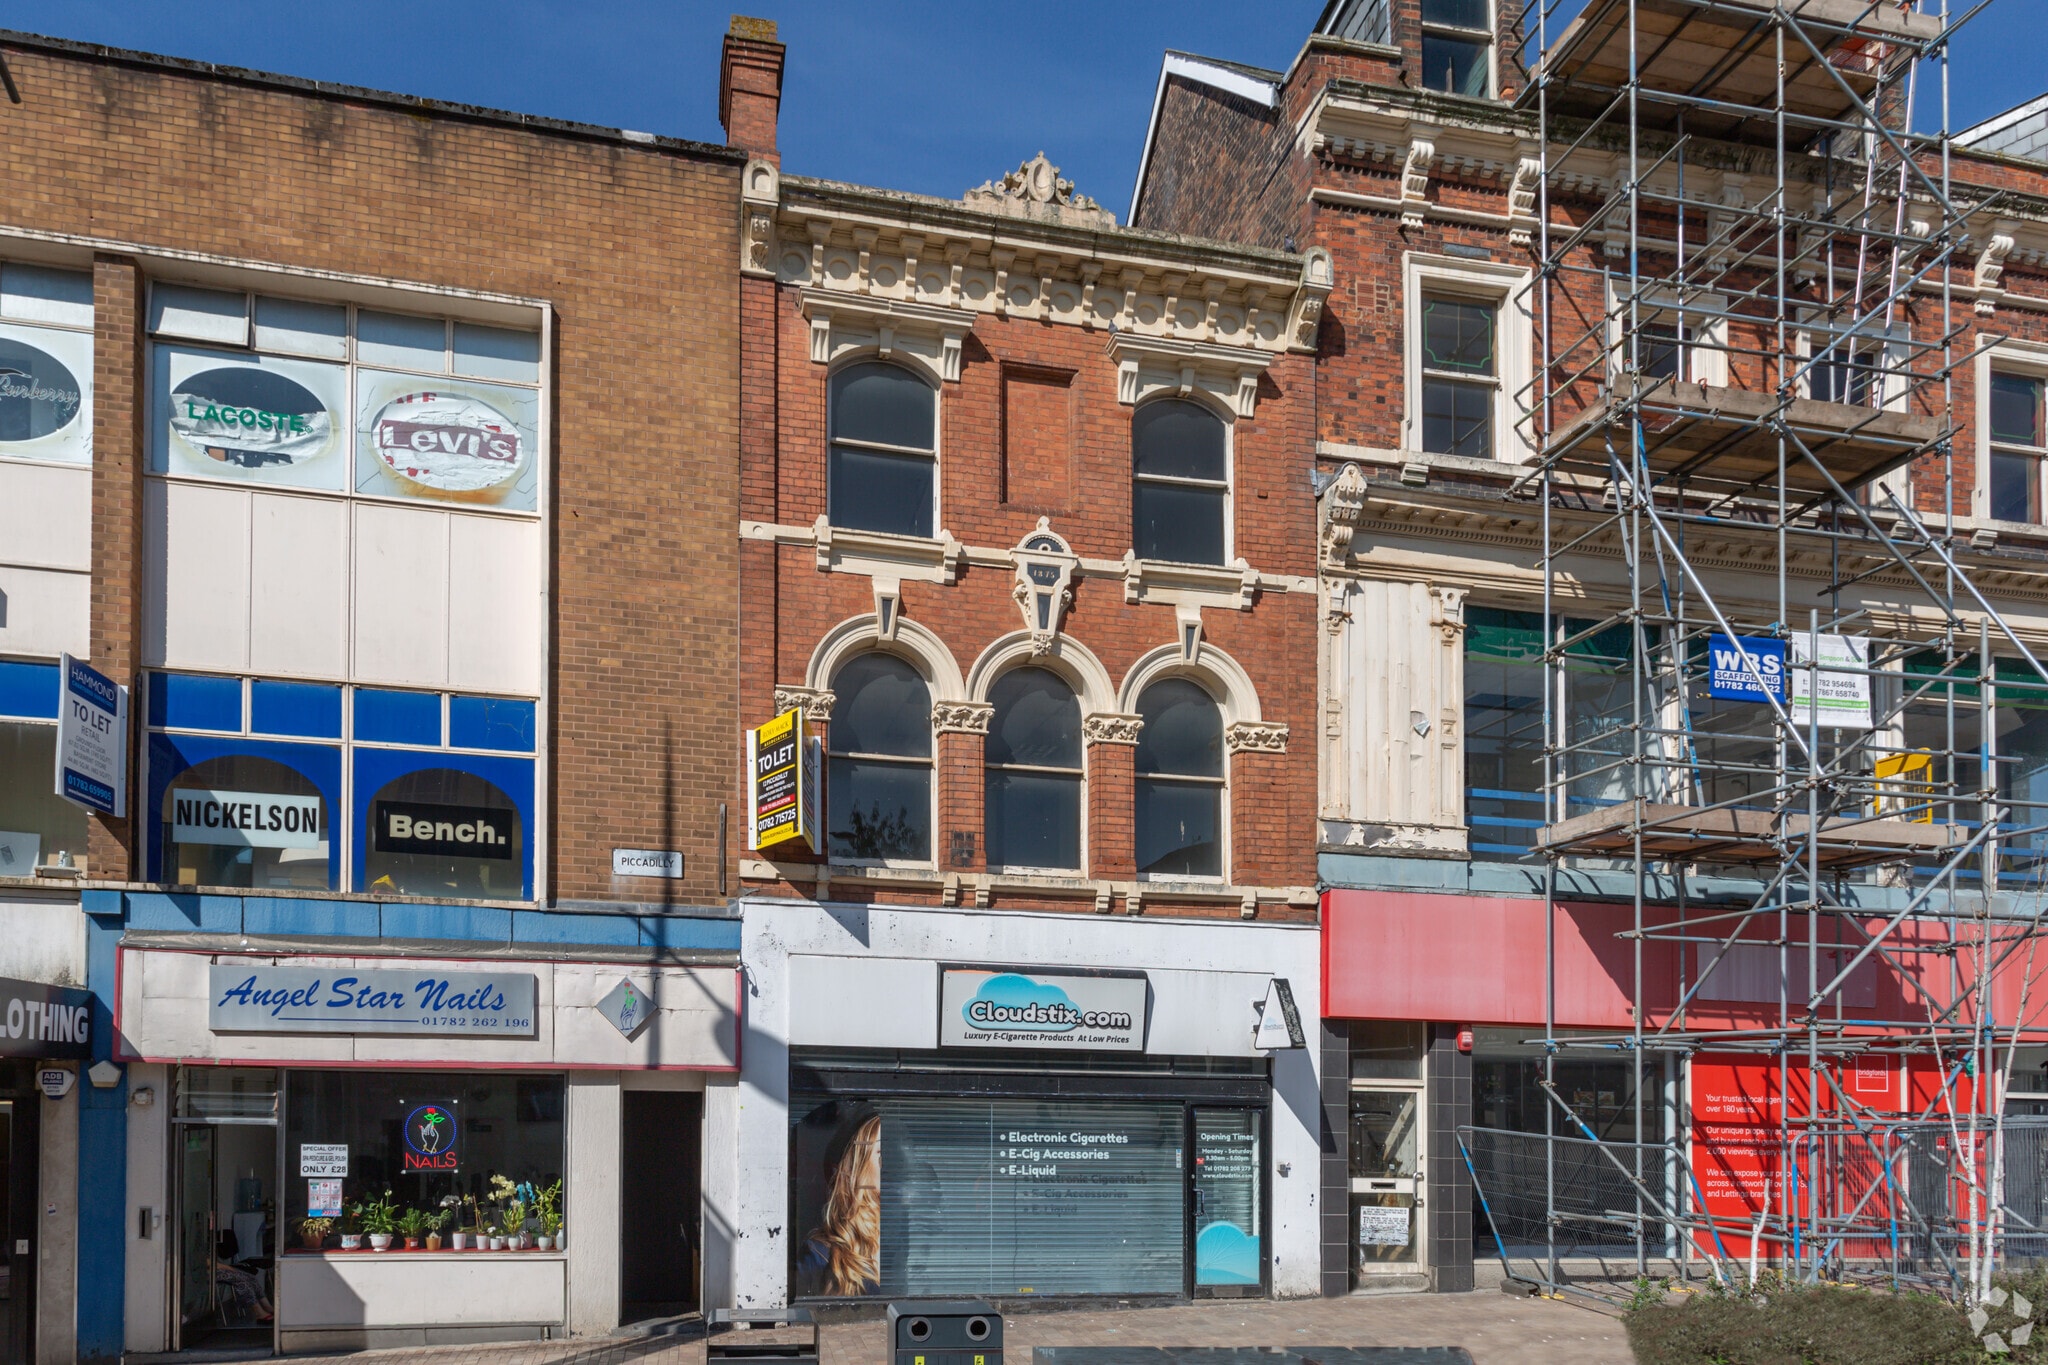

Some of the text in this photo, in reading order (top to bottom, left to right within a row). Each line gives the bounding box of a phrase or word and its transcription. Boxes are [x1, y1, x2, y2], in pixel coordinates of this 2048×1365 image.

[188, 402, 305, 433] LACOSTE
[382, 425, 513, 459] Levi's
[1714, 649, 1780, 674] WBS
[71, 666, 115, 701] HAMMOND
[1714, 681, 1743, 690] 01782
[72, 700, 111, 735] TO LET
[81, 725, 100, 743] RETAIL
[758, 754, 772, 773] TO
[773, 743, 794, 767] LET
[68, 775, 88, 792] 01782
[176, 799, 317, 833] NICKELSON
[758, 808, 796, 831] 01782 715725
[389, 814, 506, 845] Bench.
[621, 857, 674, 868] PICCADILLY
[218, 975, 508, 1016] Angel Star Nails
[969, 1000, 1132, 1028] Cloudstix.com
[421, 1017, 530, 1028] 01782 262 196
[964, 1032, 992, 1041] Luxury
[993, 1032, 1038, 1042] E-Cigarette
[1039, 1034, 1074, 1042] Products
[1106, 1035, 1130, 1043] Prices
[1858, 1070, 1886, 1078] bridgfords
[1706, 1094, 1721, 1102] Your
[1722, 1095, 1746, 1103] trusted
[1723, 1105, 1735, 1113] 180
[1201, 1133, 1231, 1141] Opening
[1706, 1126, 1720, 1134] Our
[1720, 1127, 1744, 1136] unique
[1009, 1132, 1129, 1145] Electronic Cigarettes
[1720, 1138, 1739, 1146] buyer
[1009, 1149, 1110, 1161] E-Cig Accessories
[1727, 1148, 1758, 1157] viewings
[405, 1151, 457, 1169] NAILS
[302, 1165, 347, 1173] ONLY £28
[1009, 1165, 1057, 1178] E-Liquid
[1721, 1190, 1749, 1199] Lettings
